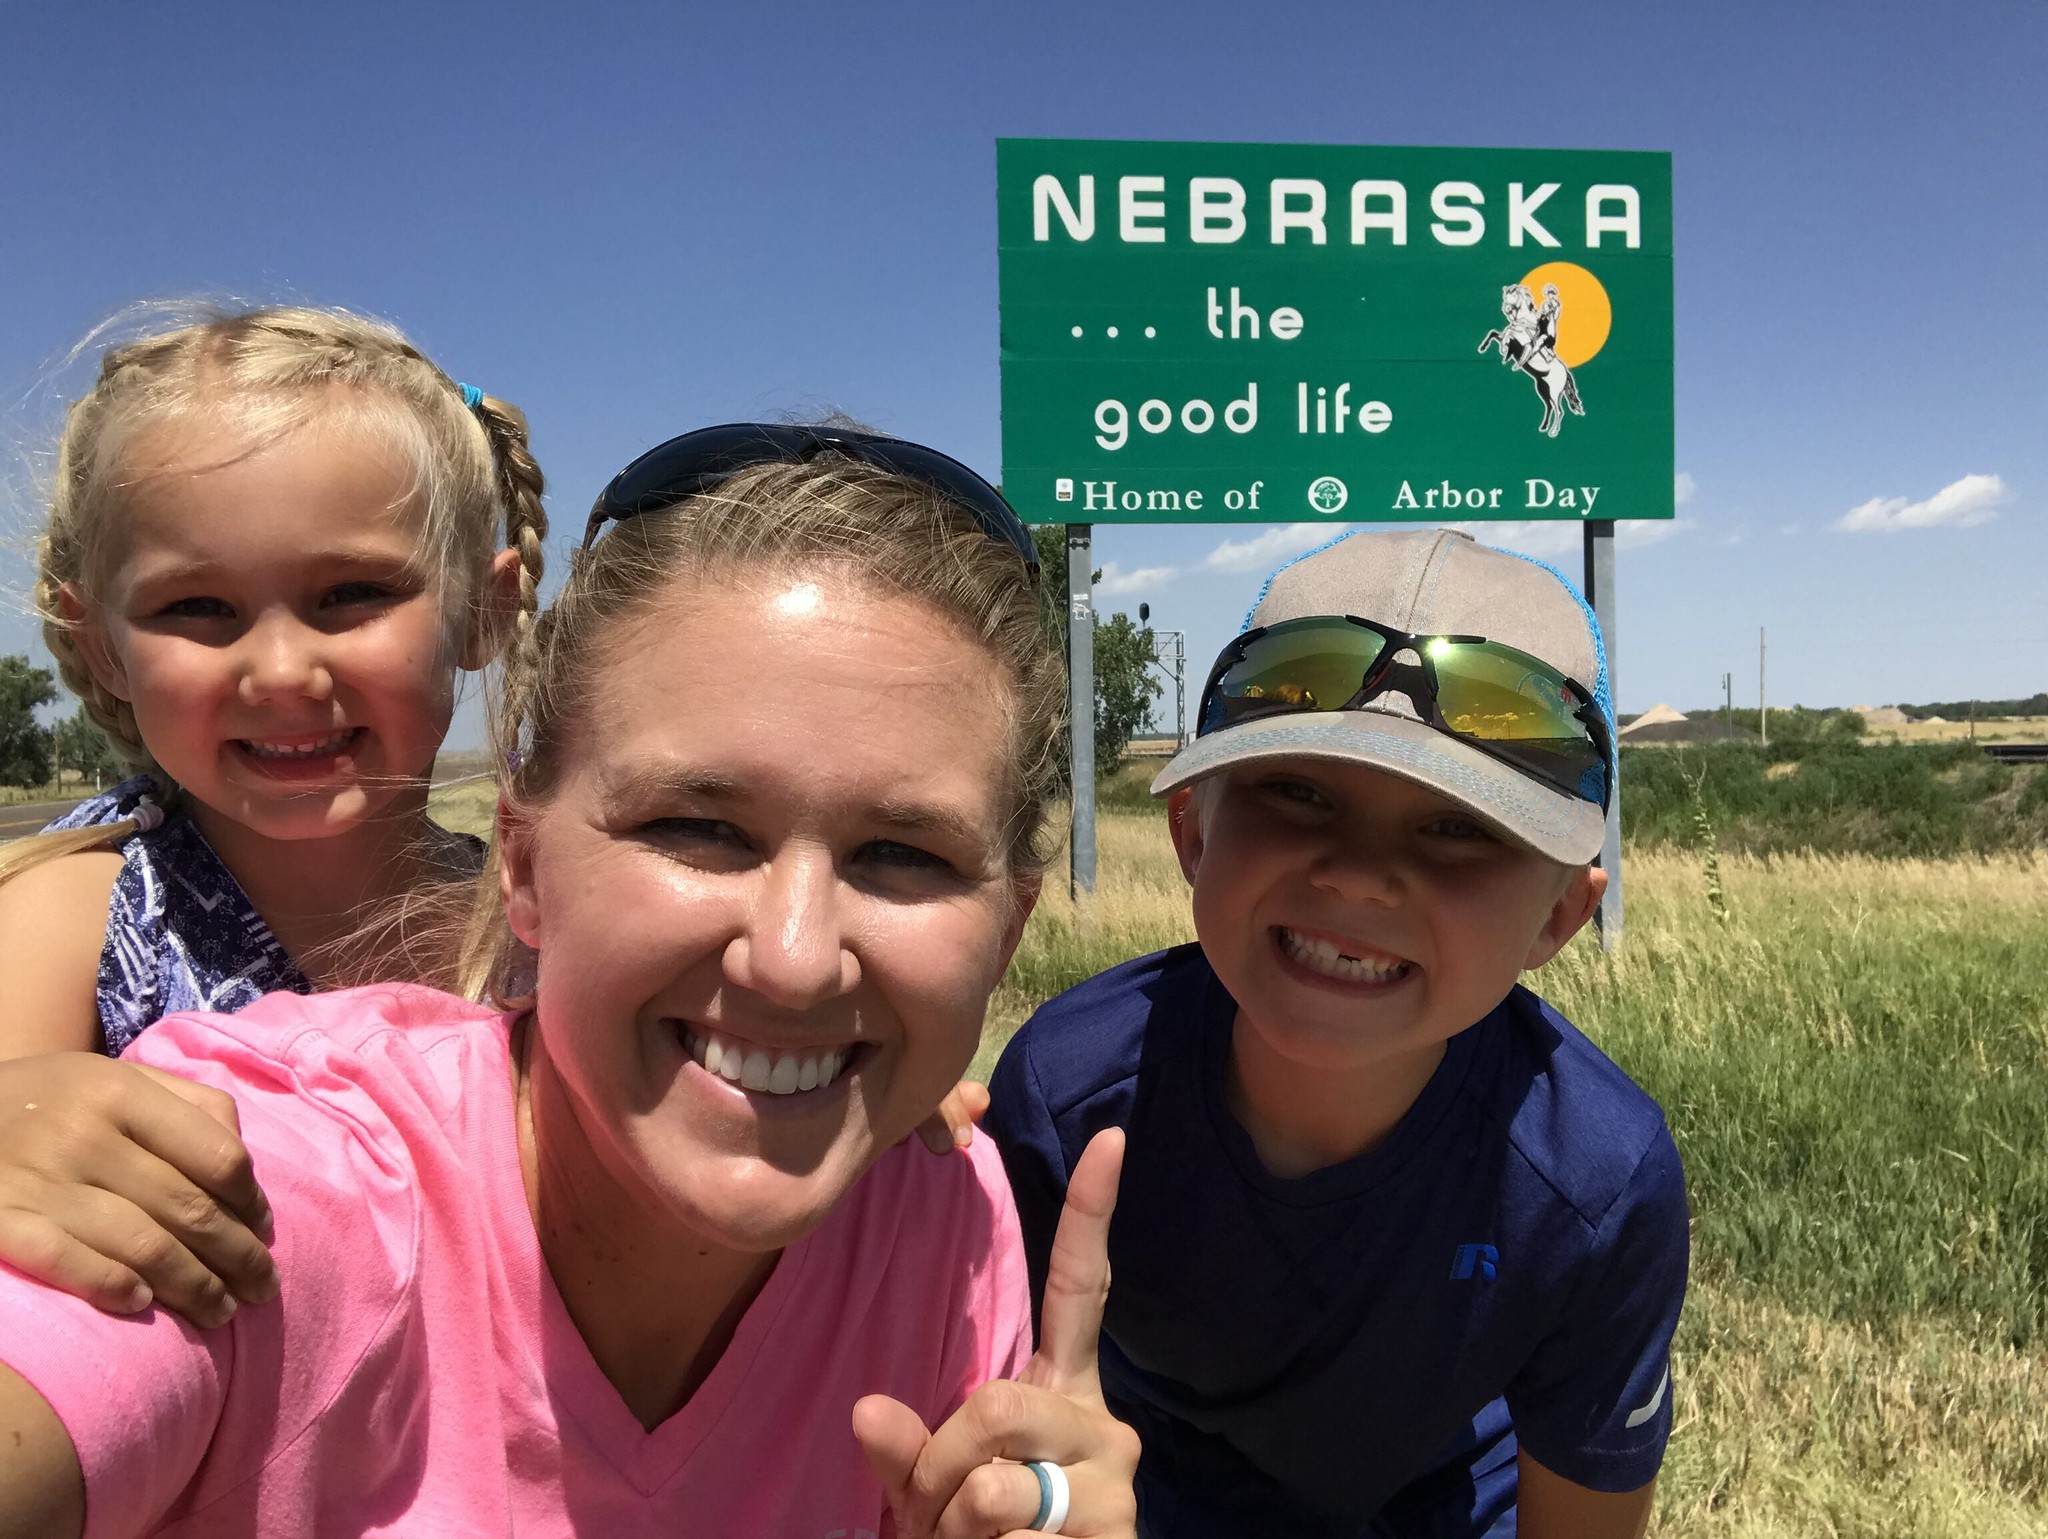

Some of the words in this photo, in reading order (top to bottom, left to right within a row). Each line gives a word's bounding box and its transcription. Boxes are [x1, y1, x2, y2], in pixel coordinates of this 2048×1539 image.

[1033, 175, 1641, 249] NEBRASKA
[1207, 287, 1304, 340] the
[1094, 382, 1258, 451] good
[1298, 382, 1393, 434] life
[1082, 481, 1203, 511] Home
[1223, 480, 1264, 510] of
[1391, 479, 1503, 509] Arbor
[1525, 478, 1600, 516] Day
